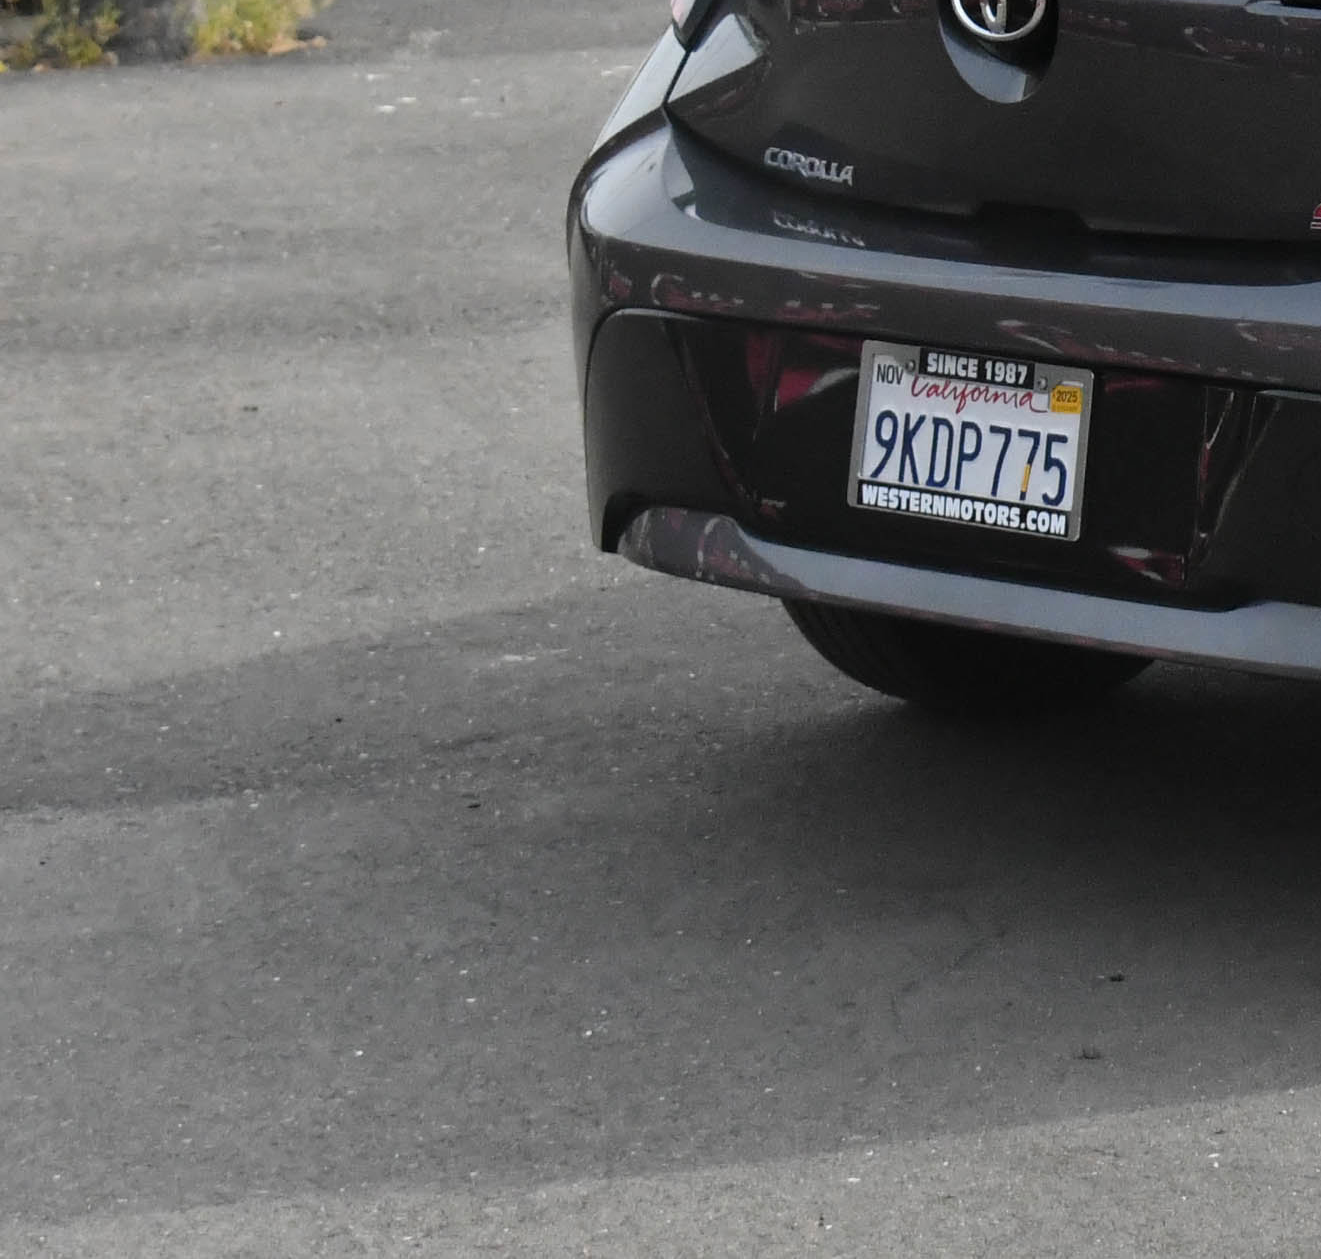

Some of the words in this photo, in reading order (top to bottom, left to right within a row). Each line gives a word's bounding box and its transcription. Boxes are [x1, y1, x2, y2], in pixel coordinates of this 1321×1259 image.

[764, 147, 854, 186] COROLLA
[876, 363, 904, 385] NOV
[926, 352, 978, 378] SINCE
[985, 361, 1028, 385] 1987
[910, 375, 1048, 414] California
[1055, 390, 1079, 403] 2025
[870, 409, 1069, 507] 9KDP775
[861, 484, 1066, 536] WESTERNMOTORS.COM
